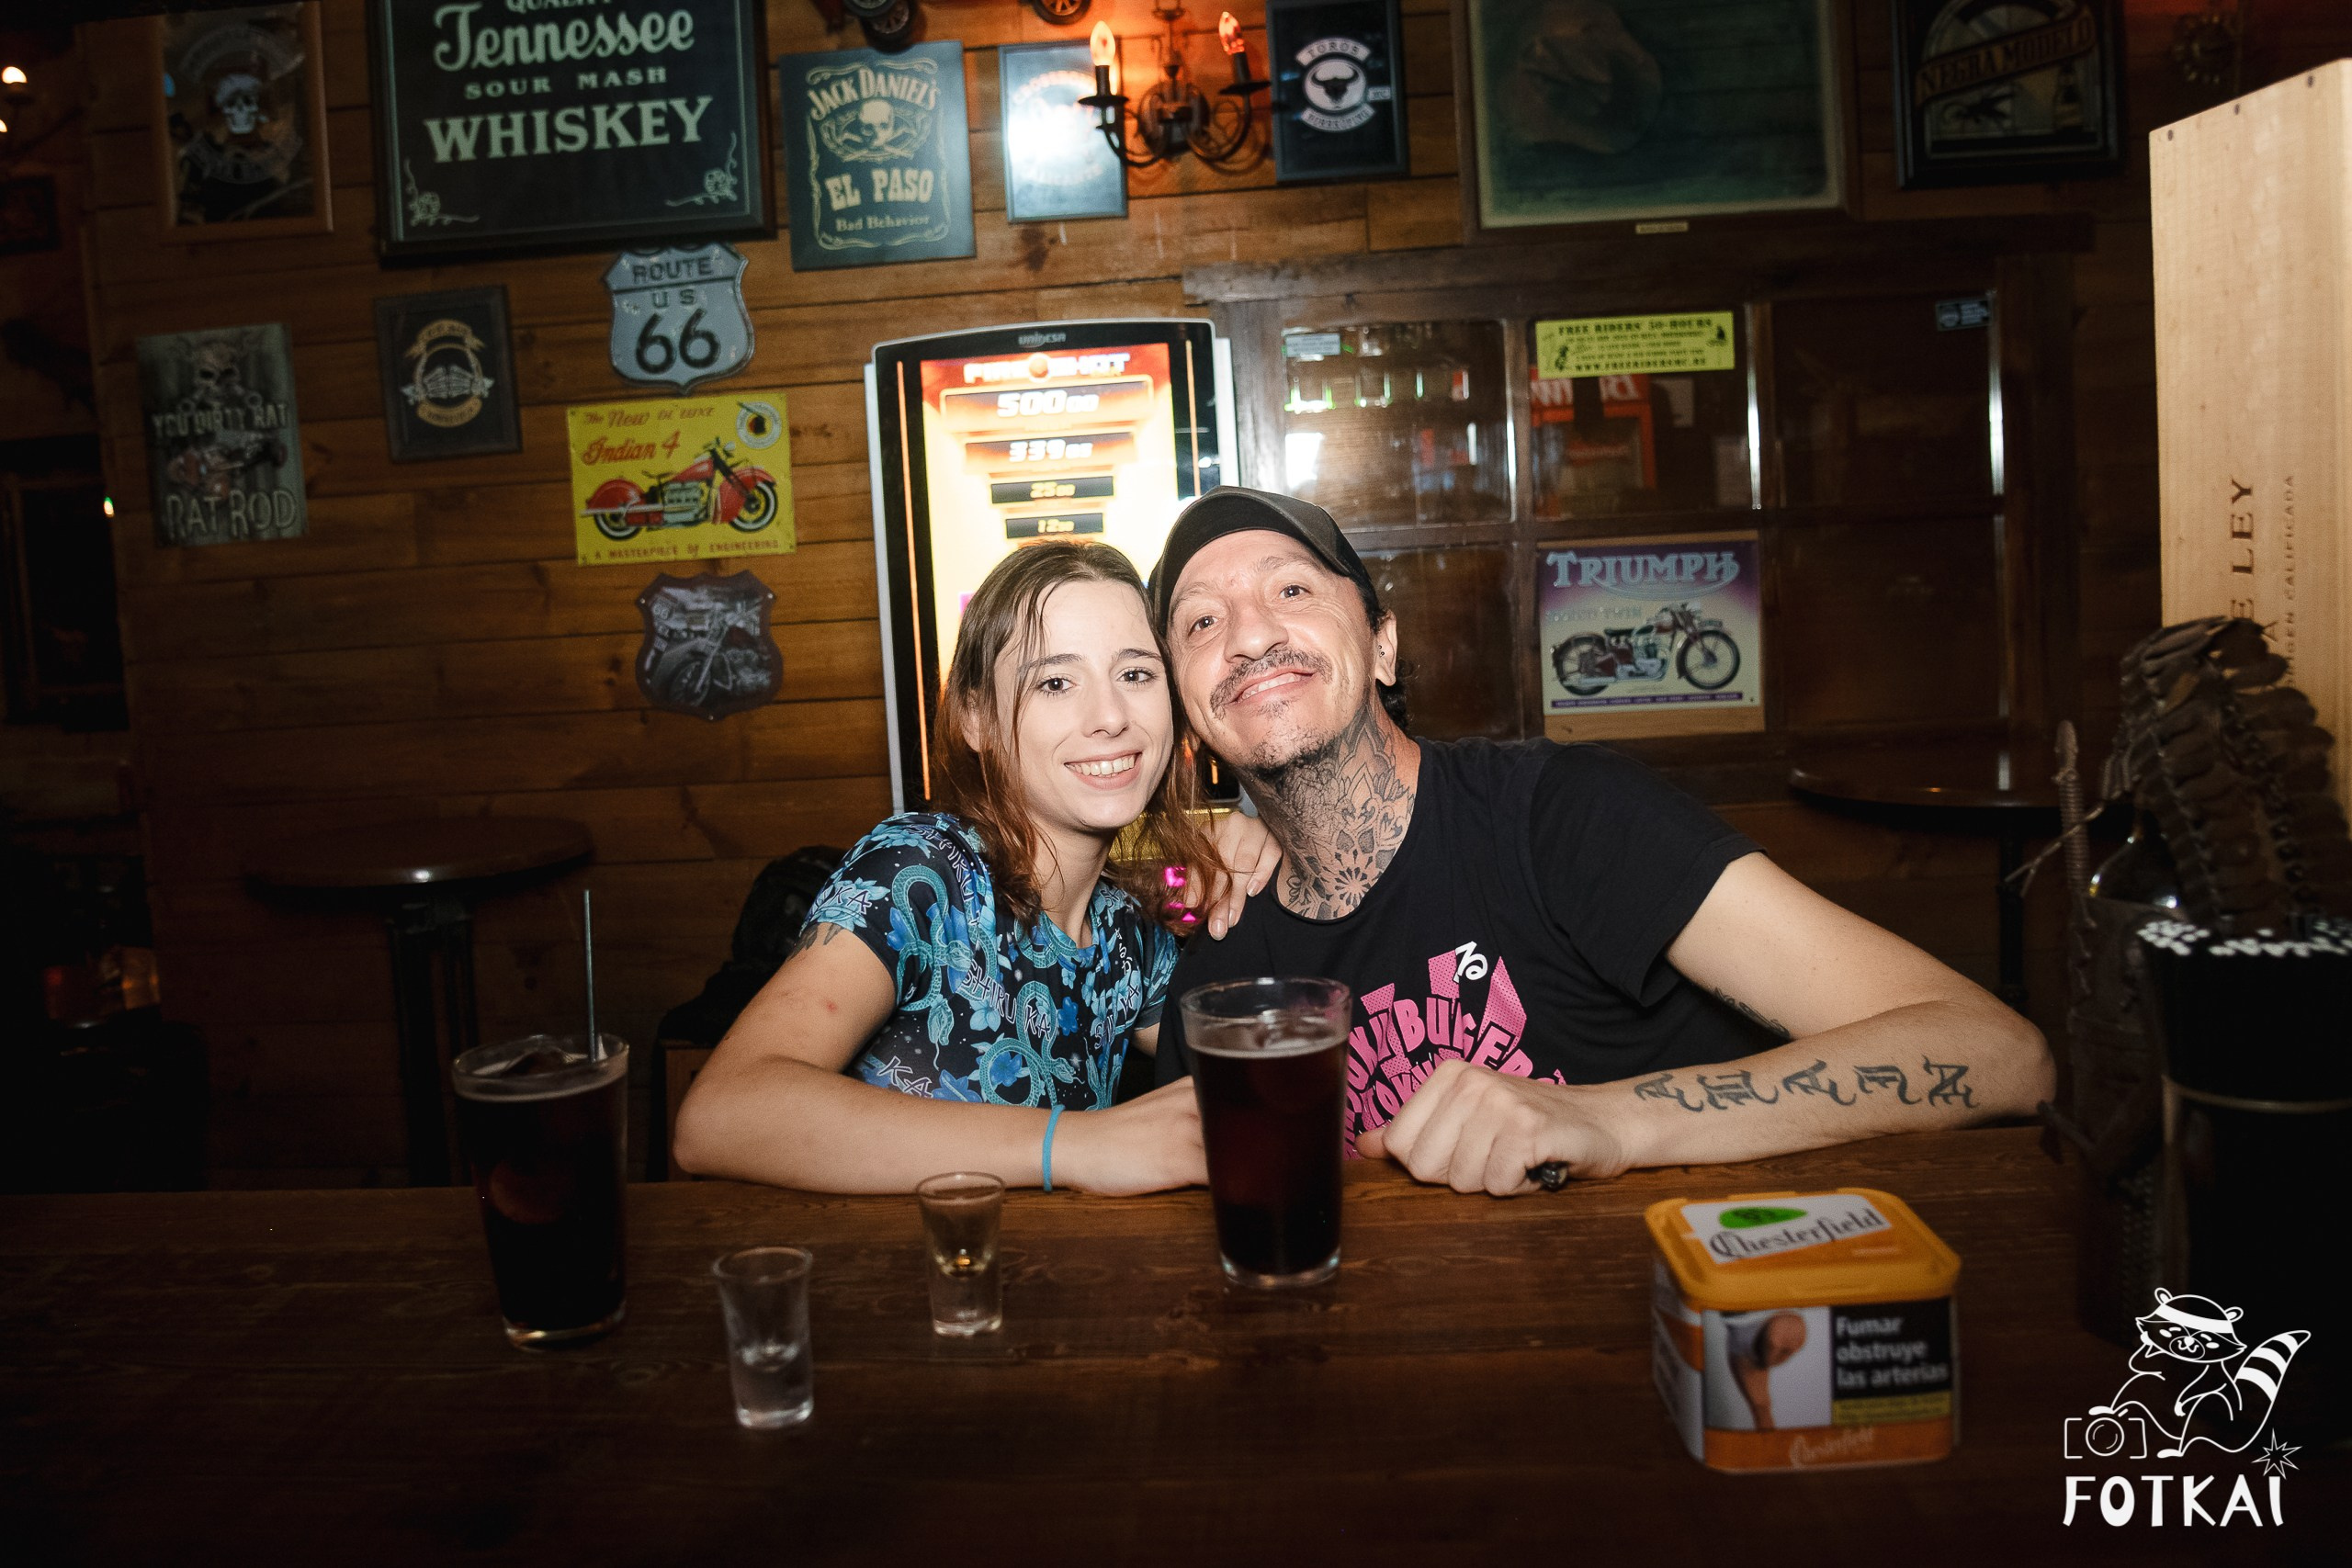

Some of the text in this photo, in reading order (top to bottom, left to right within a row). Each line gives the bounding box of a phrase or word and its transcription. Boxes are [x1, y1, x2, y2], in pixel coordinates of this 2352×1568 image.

[433, 2, 695, 71] Tennessee
[464, 67, 668, 99] SOUR MASH
[807, 75, 858, 120] JACK
[423, 96, 714, 164] WHISKEY
[825, 167, 935, 211] EL PASO
[835, 215, 864, 232] Bad
[632, 256, 712, 284] ROUTE
[636, 308, 721, 375] 66
[151, 413, 189, 437] YOU
[252, 403, 287, 429] RAT
[584, 412, 604, 425] The
[608, 409, 650, 428] New
[582, 429, 681, 466] Indian 4
[166, 489, 297, 539] RAT ROD
[2230, 474, 2254, 575] LEY
[595, 552, 602, 560] A
[608, 547, 678, 559] MASTERPIECE
[709, 539, 779, 551] ENGINEERING
[2283, 475, 2295, 601] CALIFICADA
[1546, 551, 1740, 589] TRIUMPH
[964, 959, 1053, 1041] SHIRU KA
[1710, 1208, 1883, 1262] Chesterfield
[1836, 1316, 1904, 1339] Fumar
[1836, 1340, 1928, 1365] obstruye
[1836, 1361, 1949, 1388] las arterias
